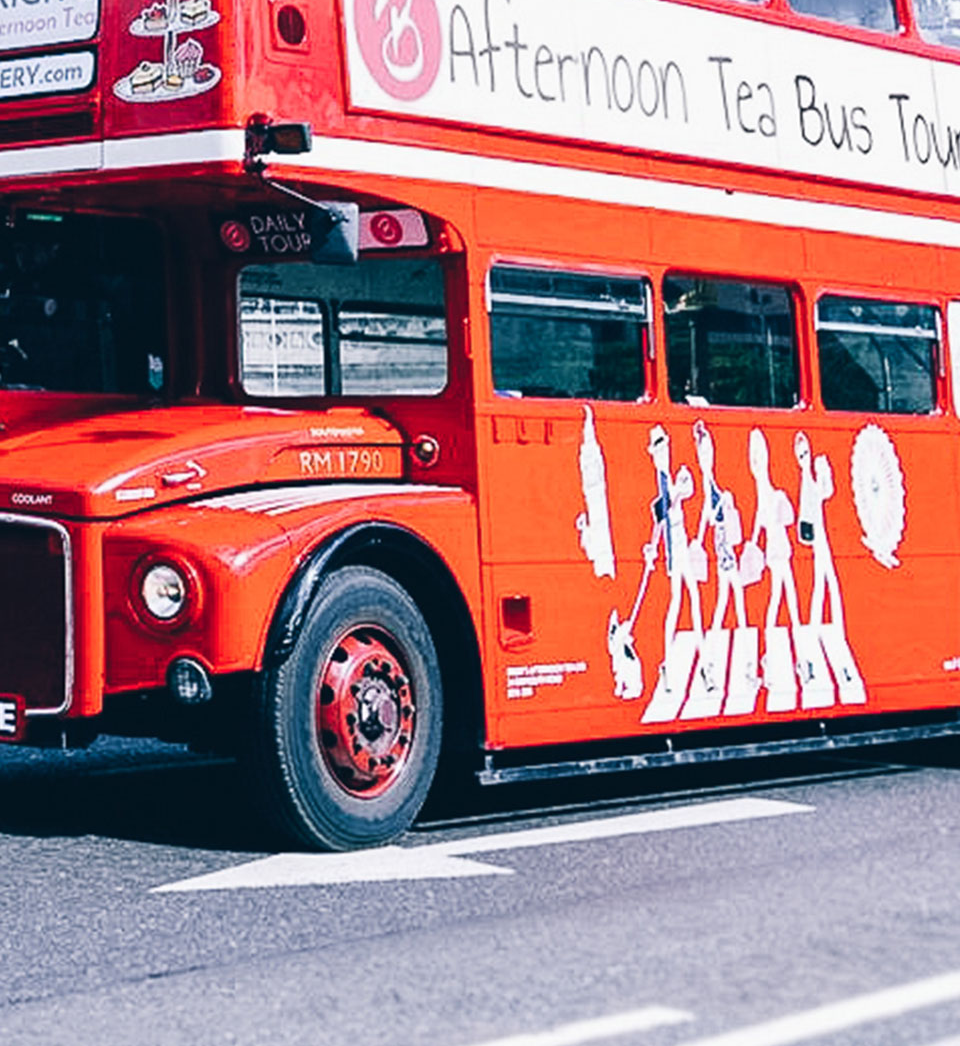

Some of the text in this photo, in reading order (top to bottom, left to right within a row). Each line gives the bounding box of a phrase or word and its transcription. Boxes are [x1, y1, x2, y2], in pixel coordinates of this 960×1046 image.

[62, 7, 96, 28] Tea
[709, 56, 778, 138] Tea
[795, 75, 873, 155] Bus
[250, 212, 305, 234] DAILY
[258, 233, 312, 253] TOUR
[299, 449, 383, 475] RM 1790
[11, 492, 53, 505] COOLANT
